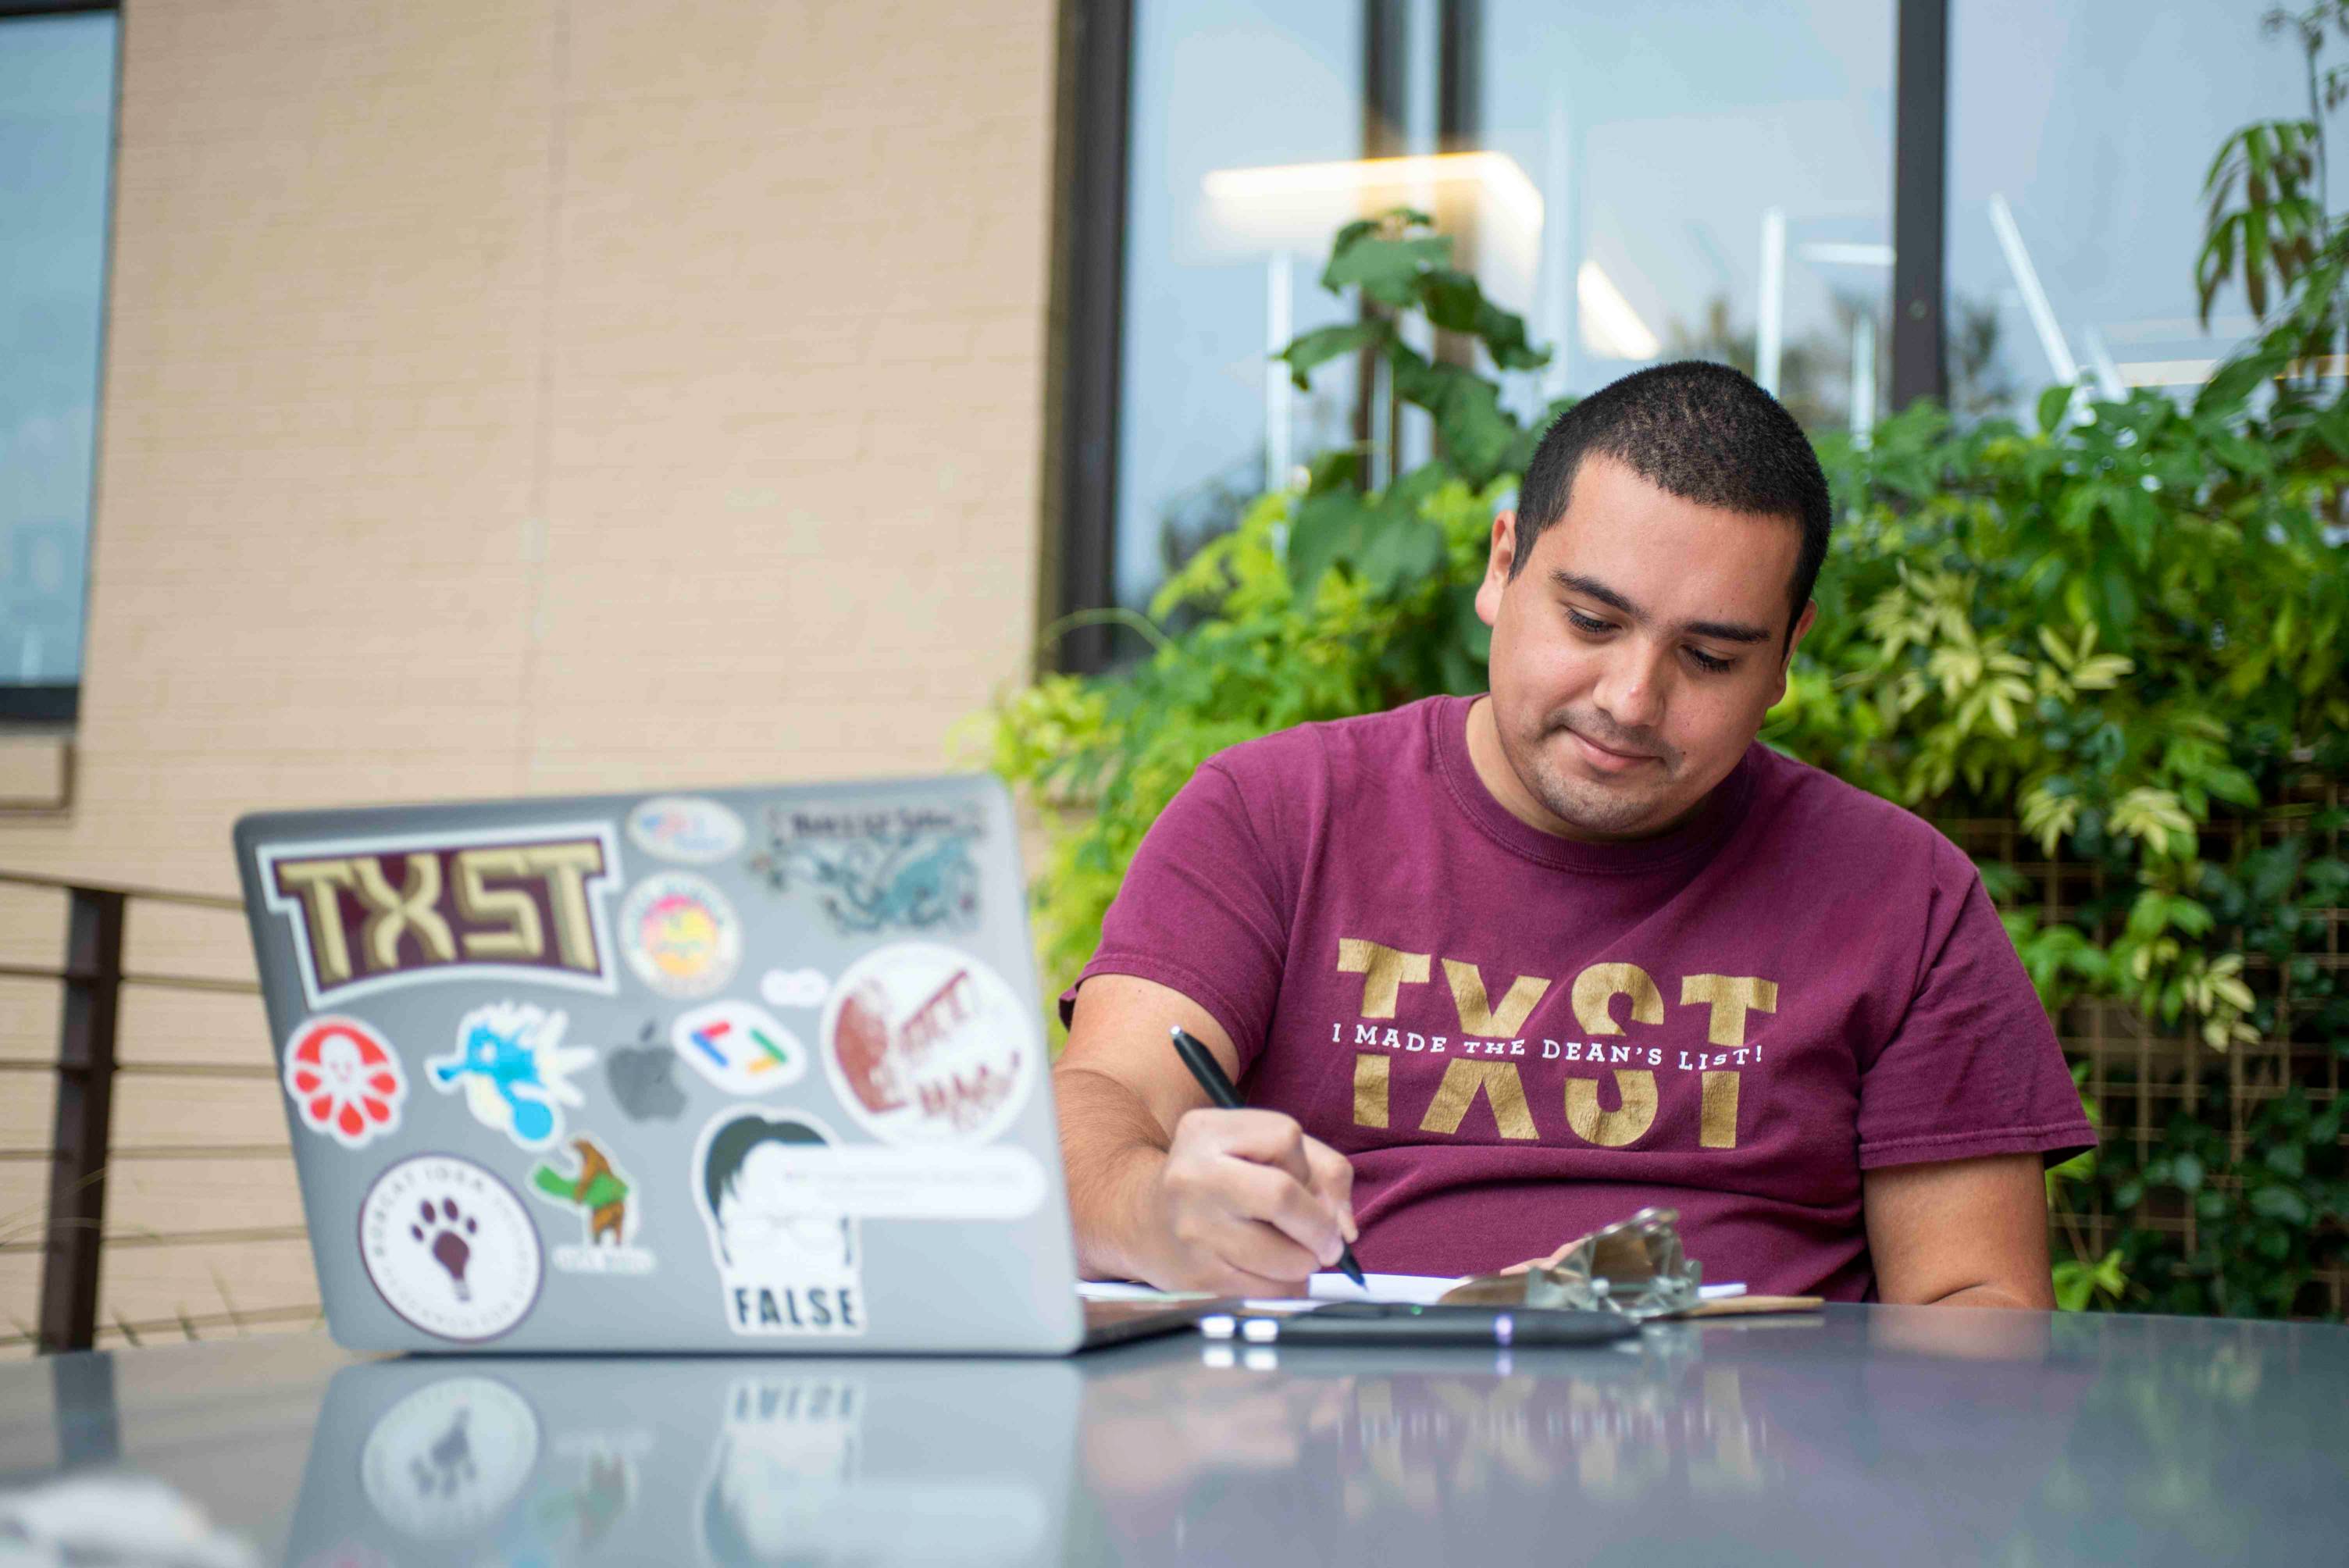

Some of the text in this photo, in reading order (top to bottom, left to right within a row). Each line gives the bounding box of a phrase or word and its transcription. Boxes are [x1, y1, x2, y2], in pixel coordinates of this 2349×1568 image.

[277, 840, 603, 985] TXST
[1332, 1023, 1763, 1071] I MADE THE DEAN'S LIST!
[1336, 938, 1779, 1149] TXST
[734, 1288, 857, 1327] FALSE
